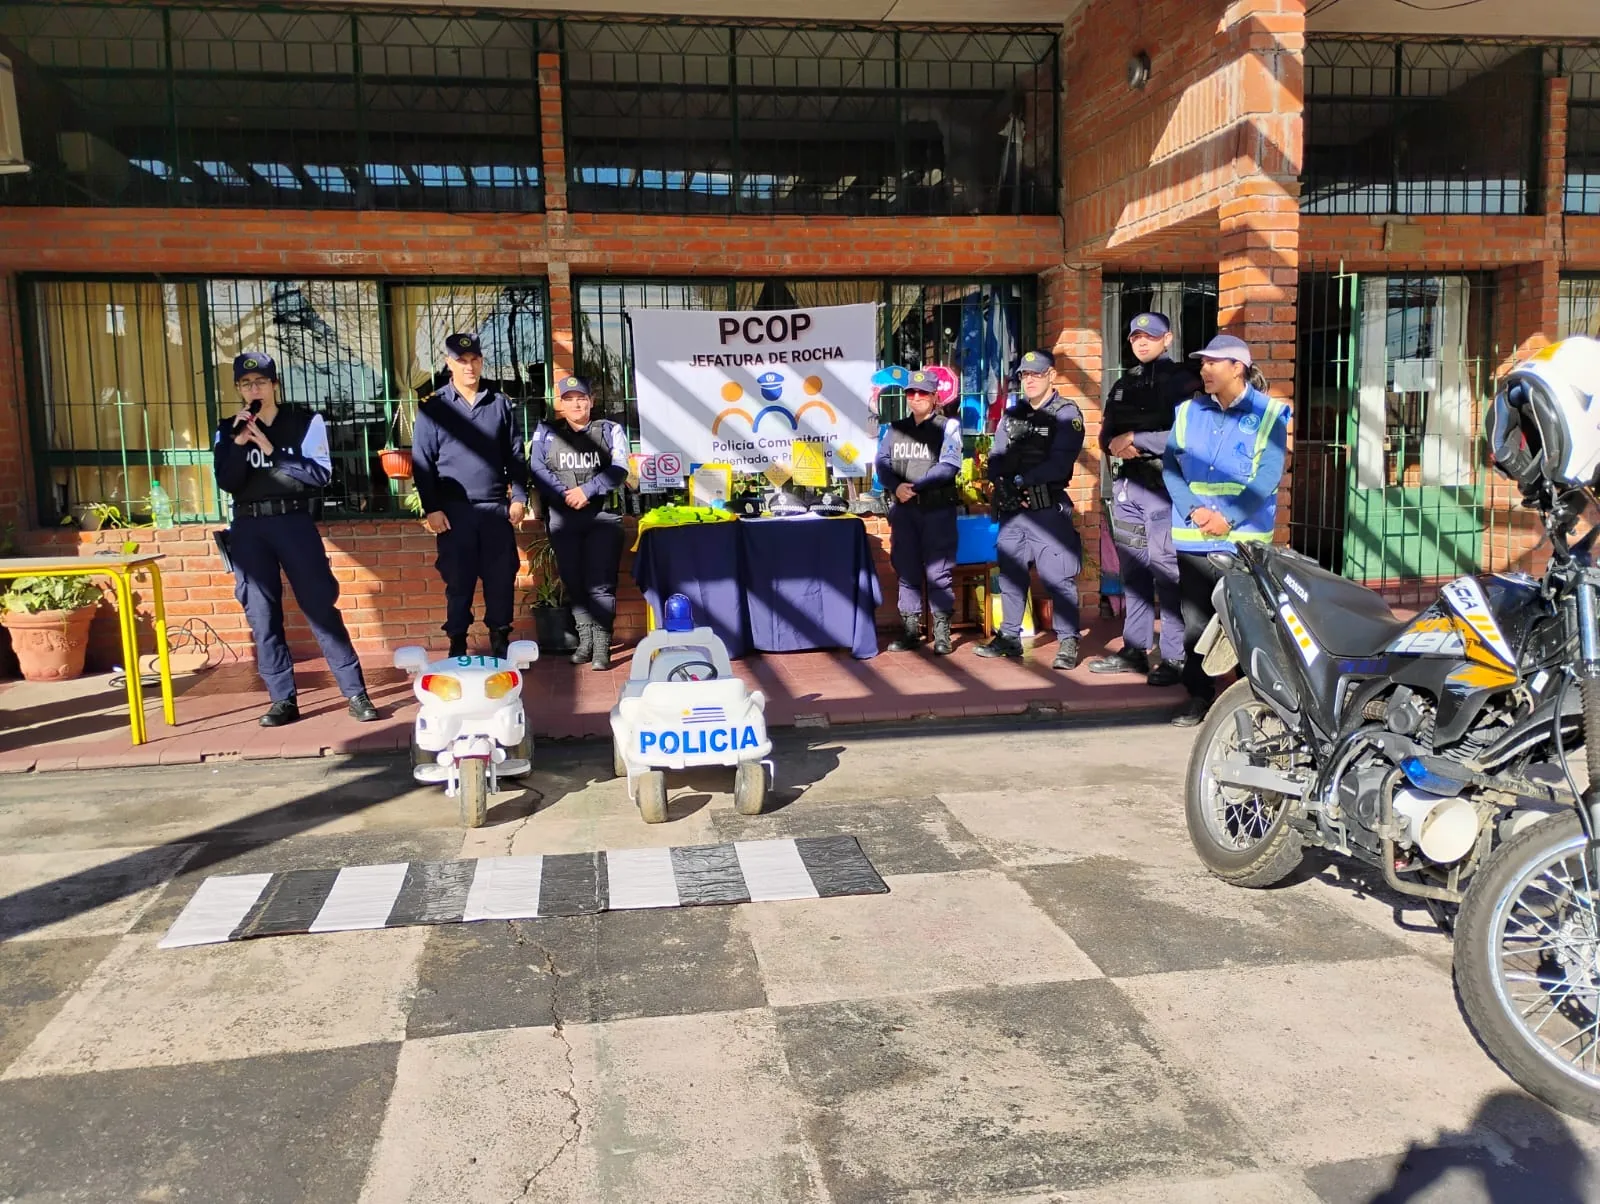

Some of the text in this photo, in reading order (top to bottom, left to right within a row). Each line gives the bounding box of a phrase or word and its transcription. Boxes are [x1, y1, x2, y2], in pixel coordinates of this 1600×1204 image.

[718, 313, 812, 345] PCOP
[689, 346, 844, 367] JEFATURA DE ROCHA
[559, 451, 601, 469] POLICIA
[893, 442, 930, 459] POLICIA
[1283, 573, 1309, 603] HONDA
[457, 655, 499, 668] 911
[639, 725, 759, 755] POLICIA
